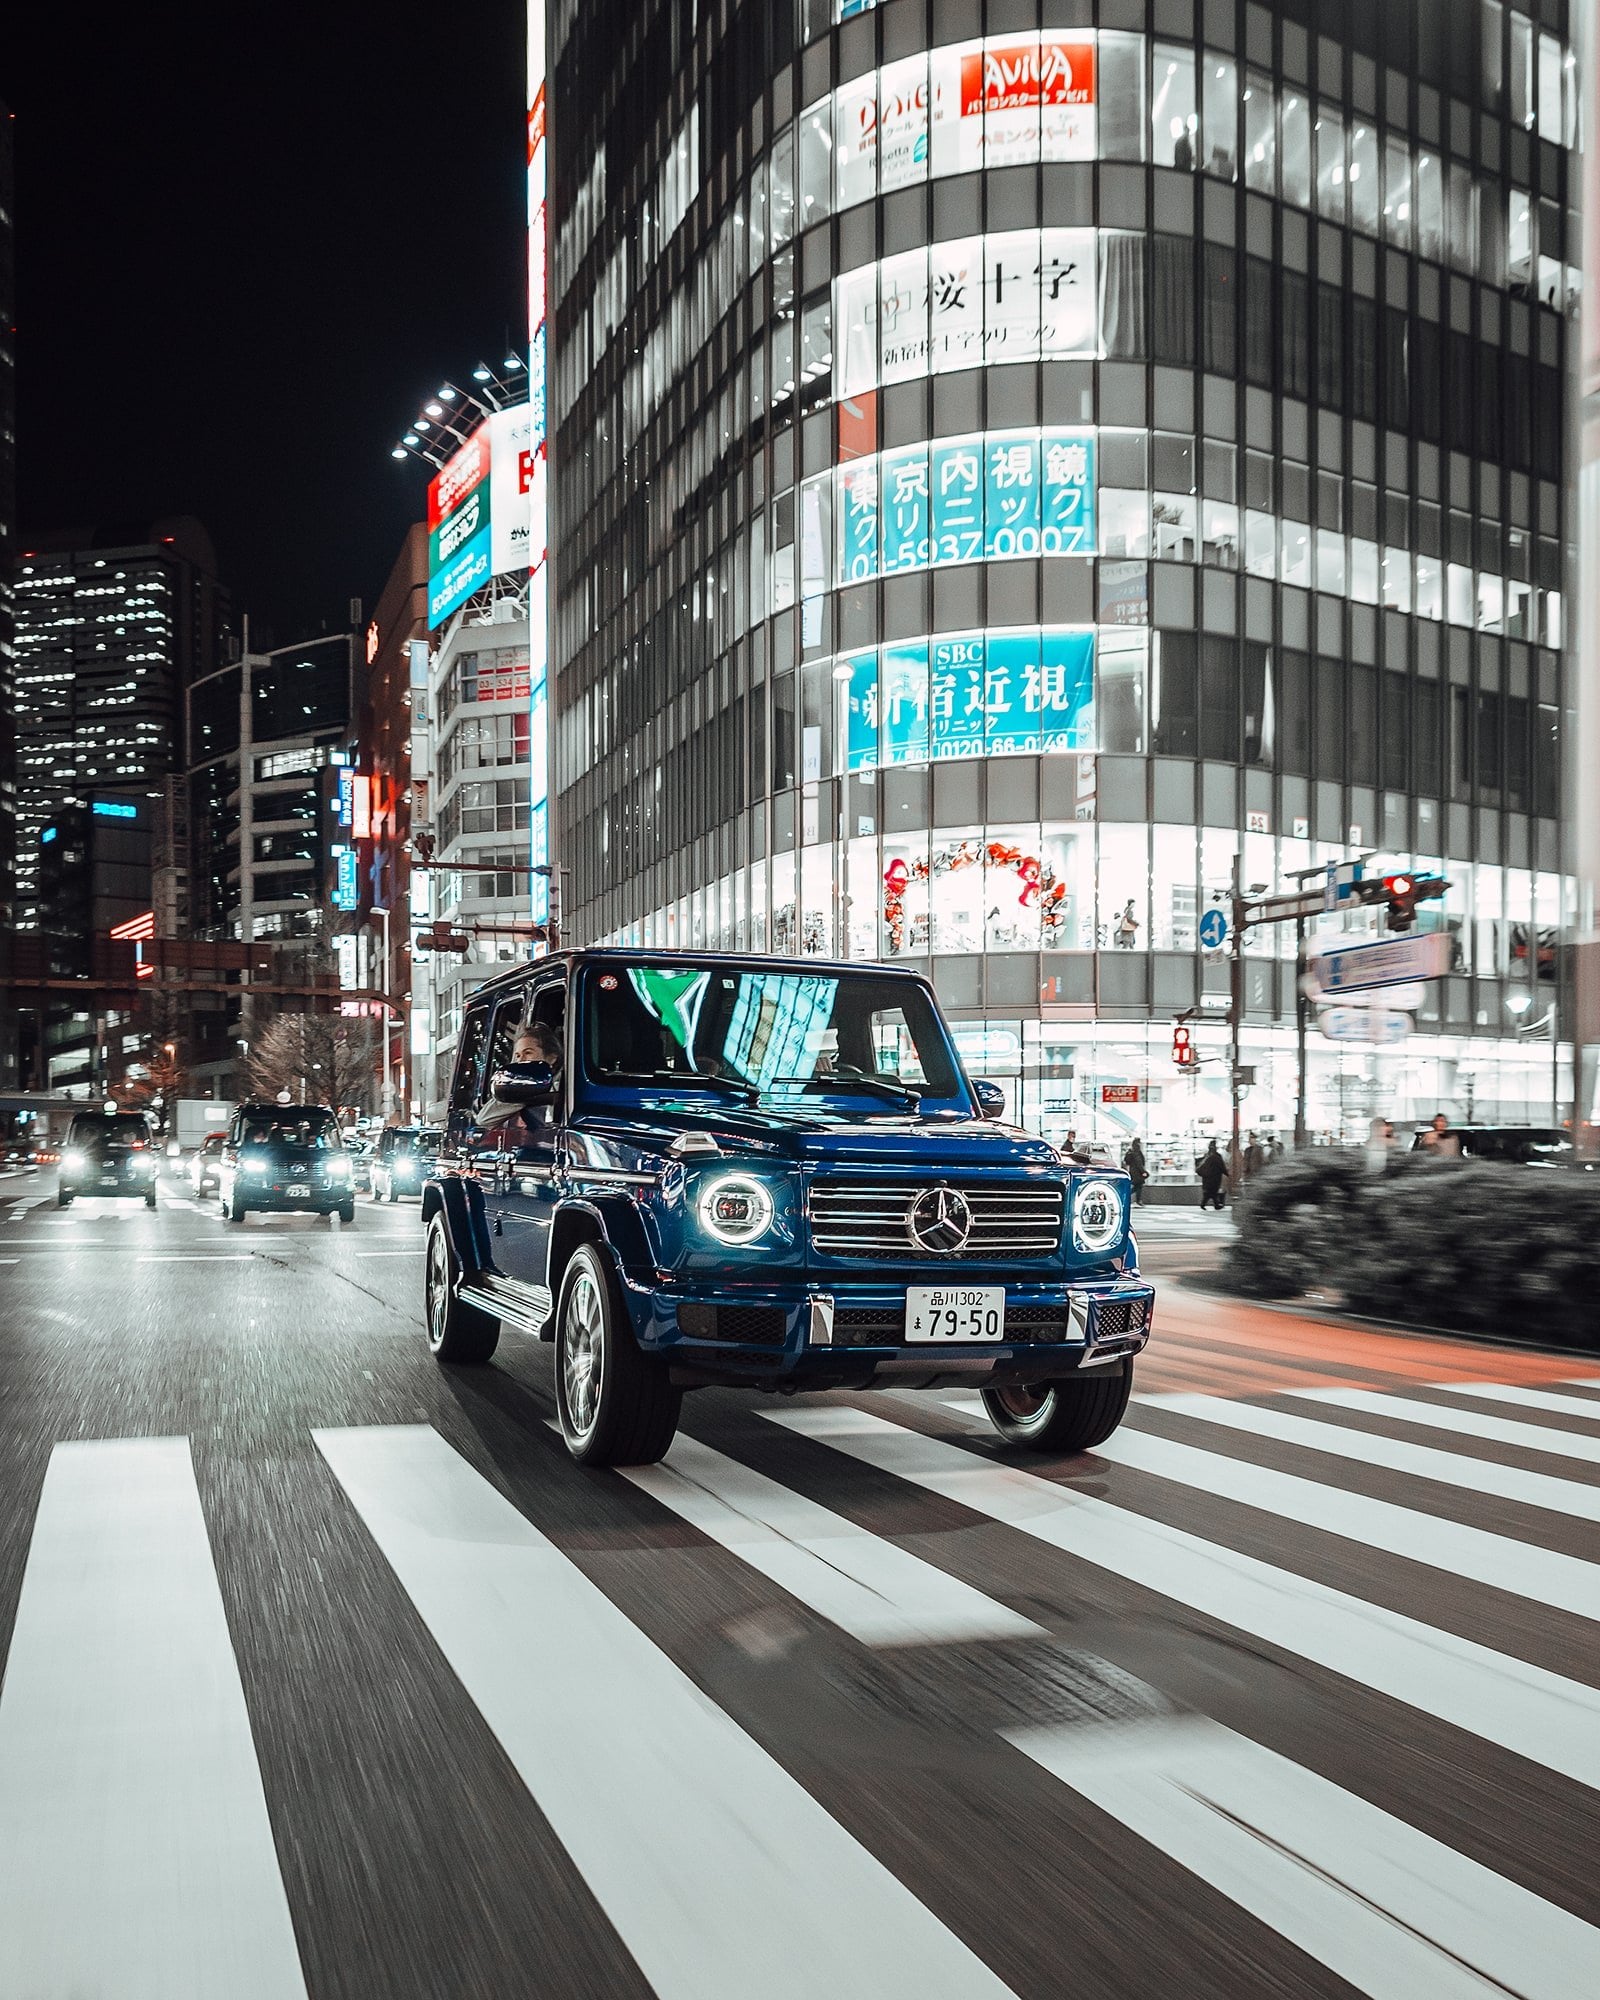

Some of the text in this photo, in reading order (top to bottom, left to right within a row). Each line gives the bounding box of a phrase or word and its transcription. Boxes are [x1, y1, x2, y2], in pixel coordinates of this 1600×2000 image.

[984, 44, 1073, 96] AVIVA
[922, 258, 1078, 314] 桜十字
[849, 442, 1087, 518] 東京内視鏡
[853, 488, 1082, 550] クリニック
[850, 526, 1086, 581] 03-5937-0007
[937, 641, 984, 666] SBC
[862, 662, 1070, 730] 新宿近視
[928, 1309, 999, 1337] 79-50
